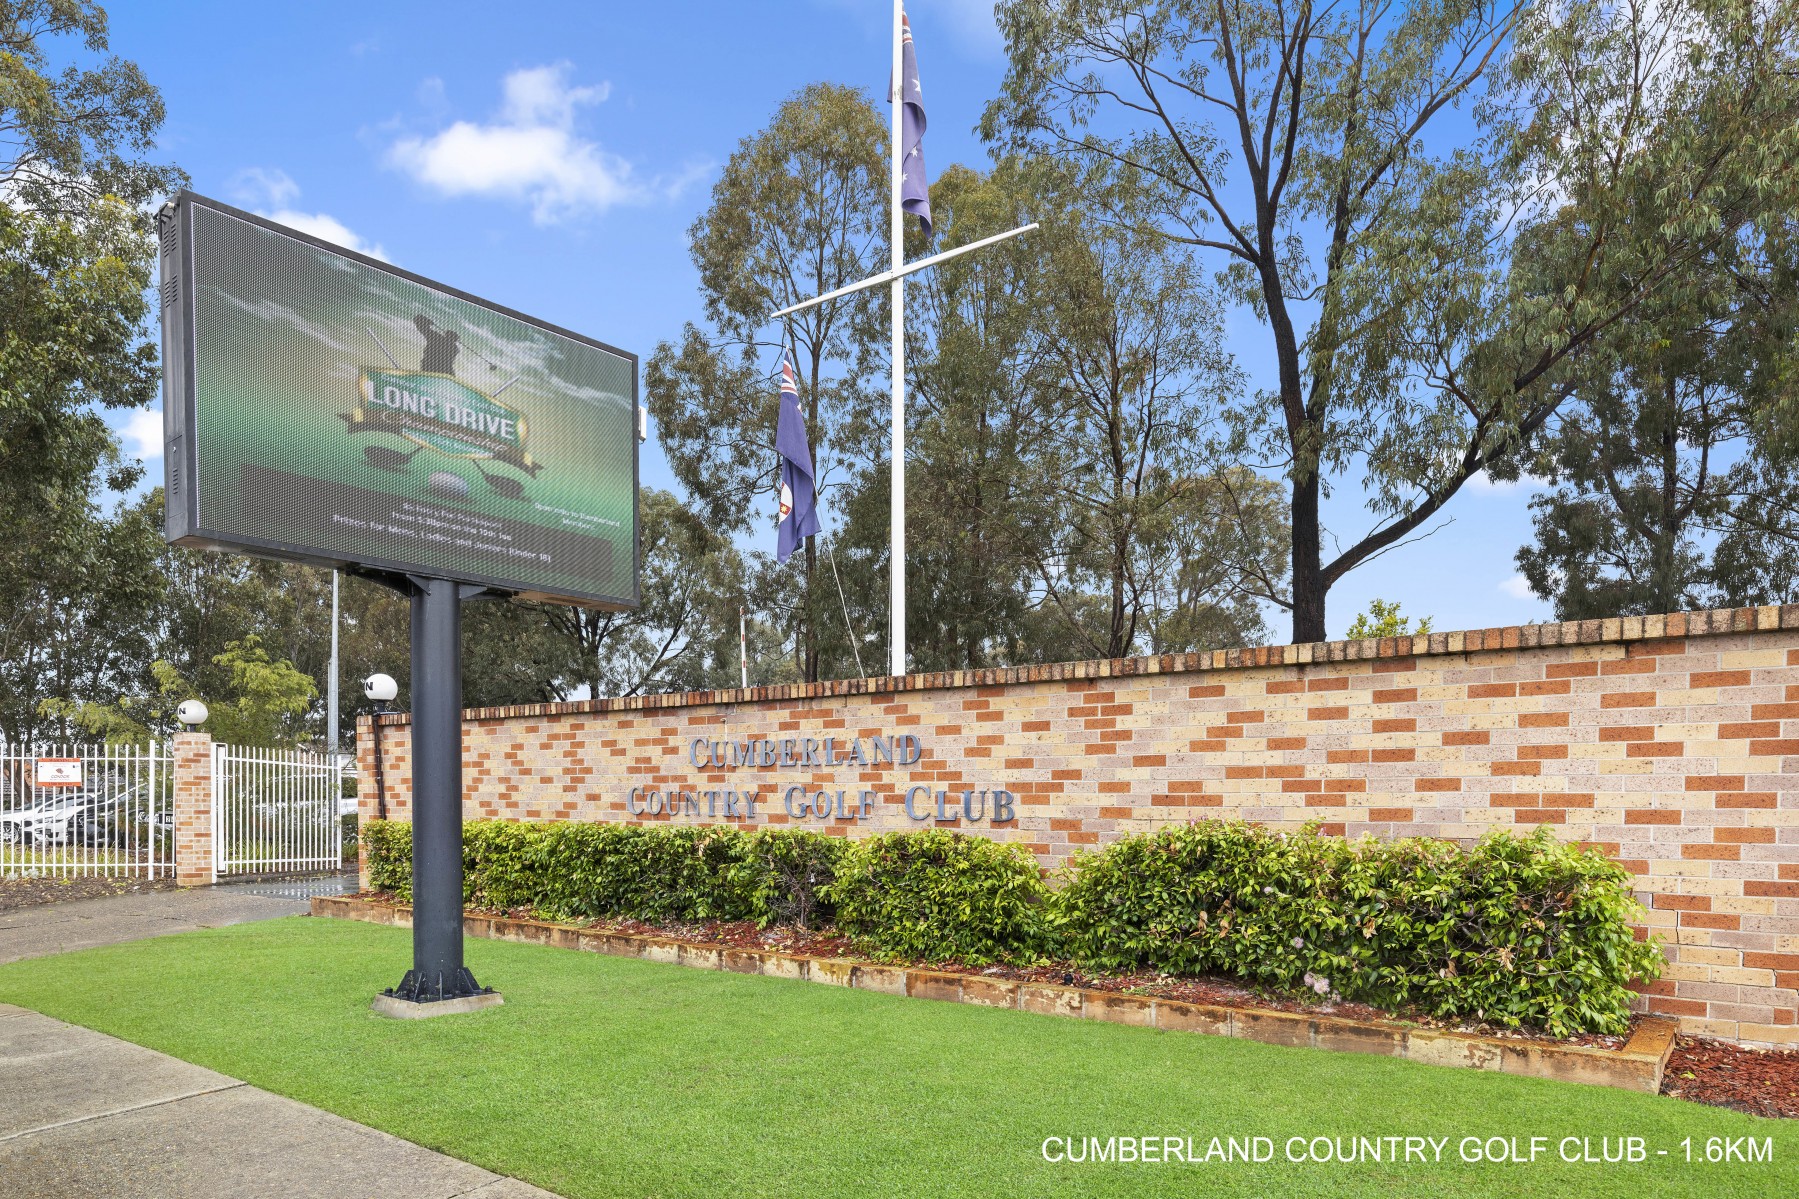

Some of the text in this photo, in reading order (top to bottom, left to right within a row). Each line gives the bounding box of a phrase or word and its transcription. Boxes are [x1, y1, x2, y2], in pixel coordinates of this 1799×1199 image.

[364, 380, 435, 418] LONG
[442, 402, 515, 440] DRIVE
[369, 520, 385, 532] for
[420, 529, 451, 544] Ladies
[455, 536, 472, 548] and
[689, 733, 922, 769] CUMBERLAND
[627, 784, 1016, 823] COUNTRY GOLF CLUB
